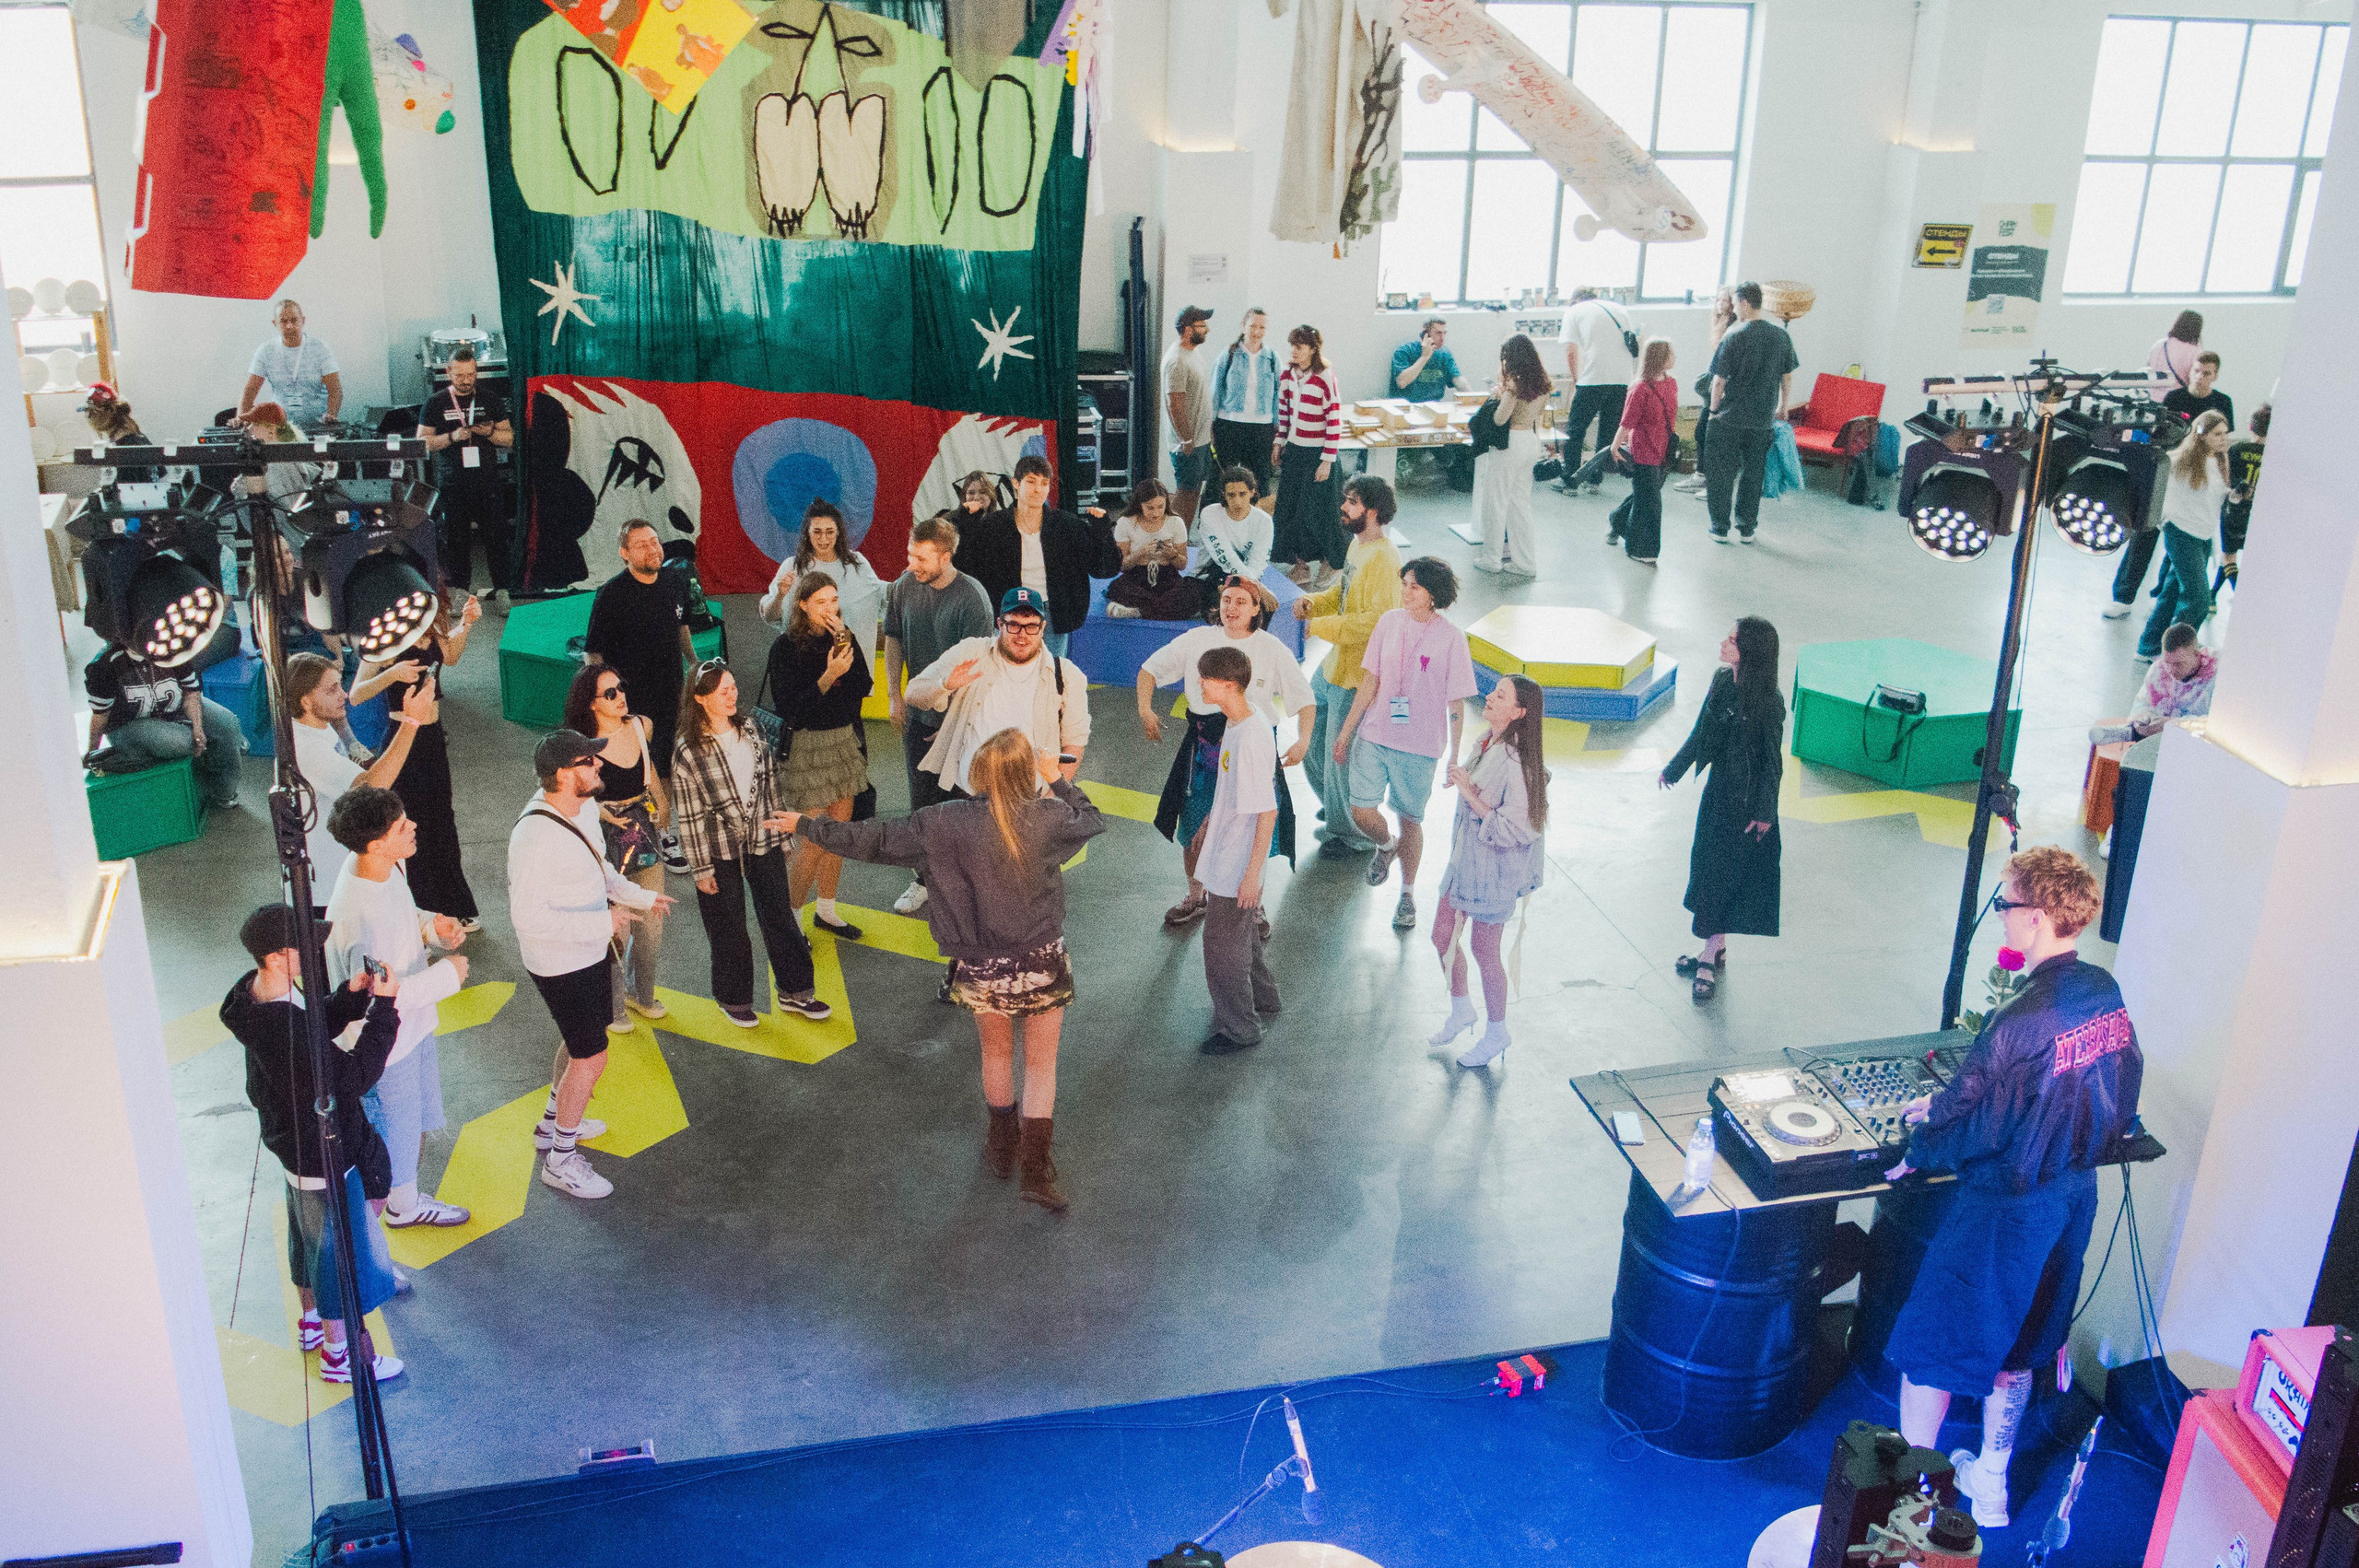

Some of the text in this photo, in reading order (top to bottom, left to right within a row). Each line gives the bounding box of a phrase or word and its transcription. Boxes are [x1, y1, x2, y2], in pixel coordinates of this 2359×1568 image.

[1925, 228, 1967, 238] СТЕНДЫ
[1017, 590, 1030, 602] B
[125, 678, 182, 719] 72
[1723, 1110, 1754, 1148] Pioneer
